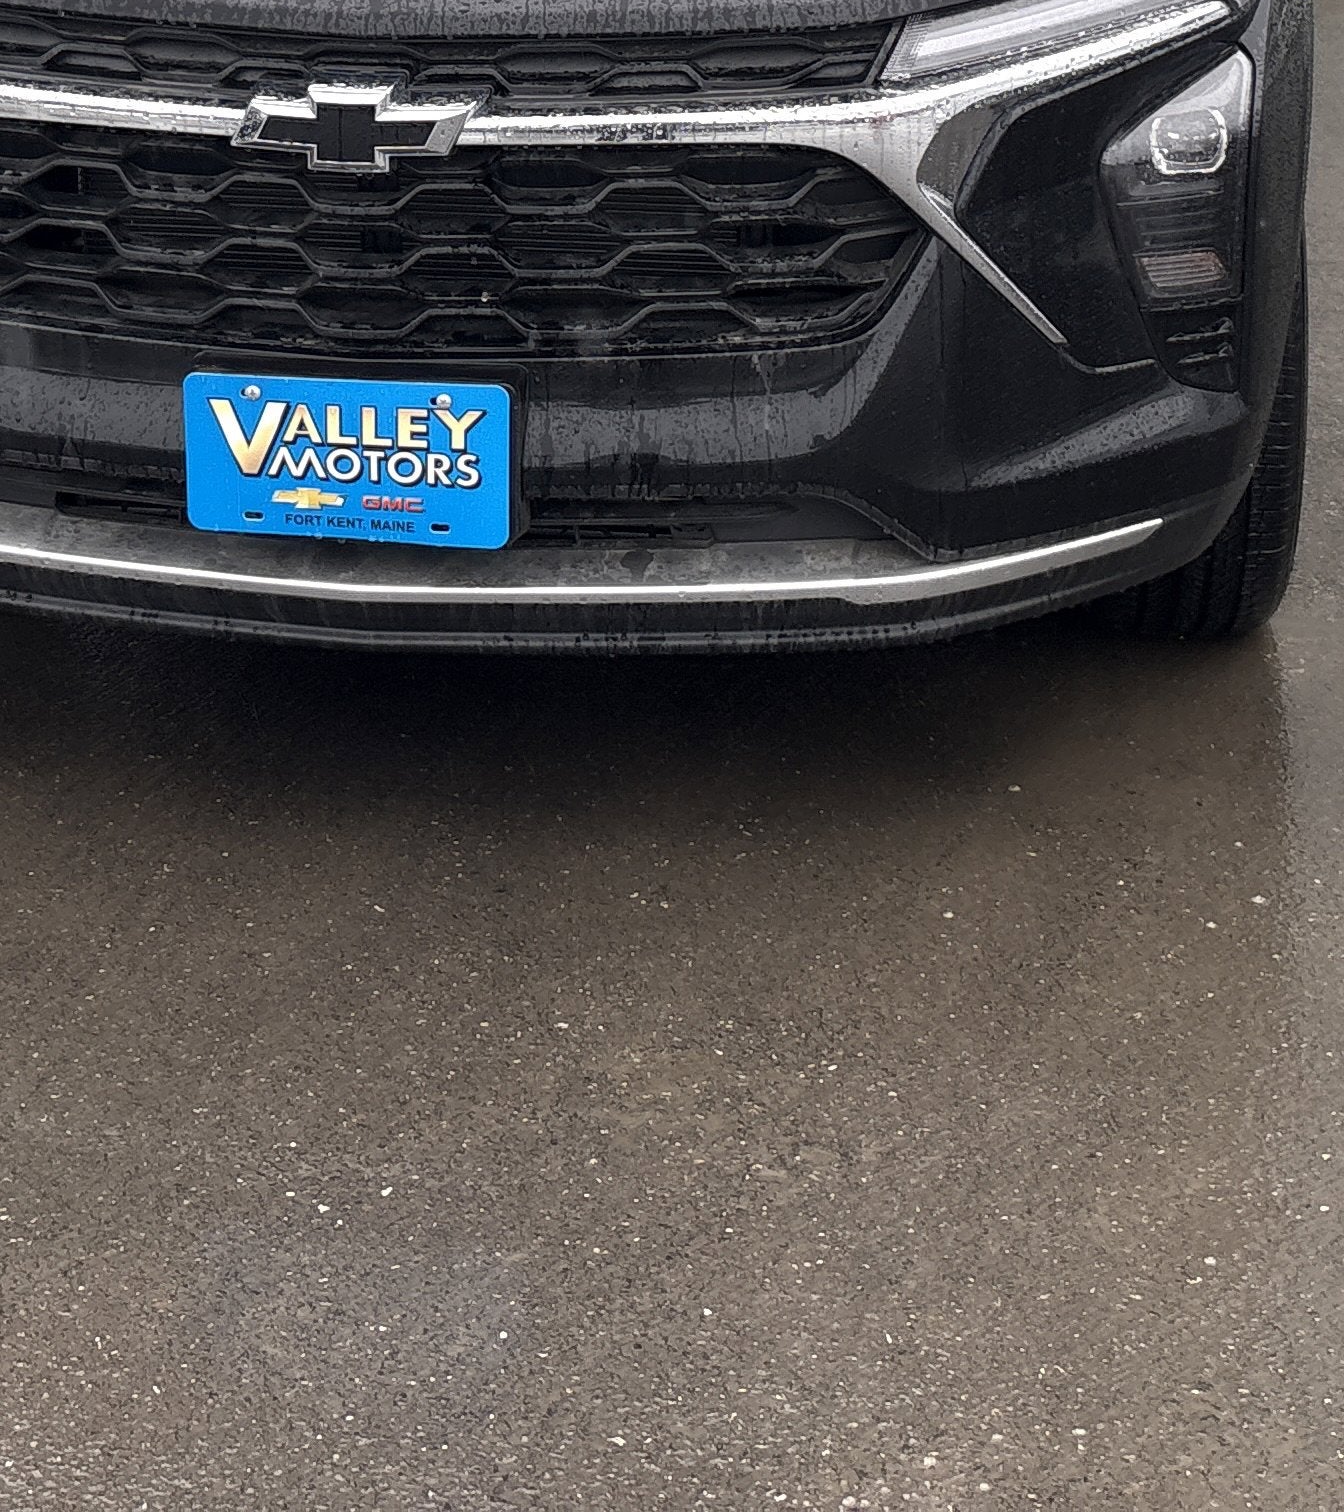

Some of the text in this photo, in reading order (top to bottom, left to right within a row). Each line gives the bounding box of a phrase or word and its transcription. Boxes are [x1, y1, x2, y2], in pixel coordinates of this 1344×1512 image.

[208, 398, 487, 477] VALLEY
[266, 445, 482, 490] MOTORS
[362, 495, 425, 513] GMC
[286, 514, 323, 527] FORT
[371, 518, 416, 532] MAINE
